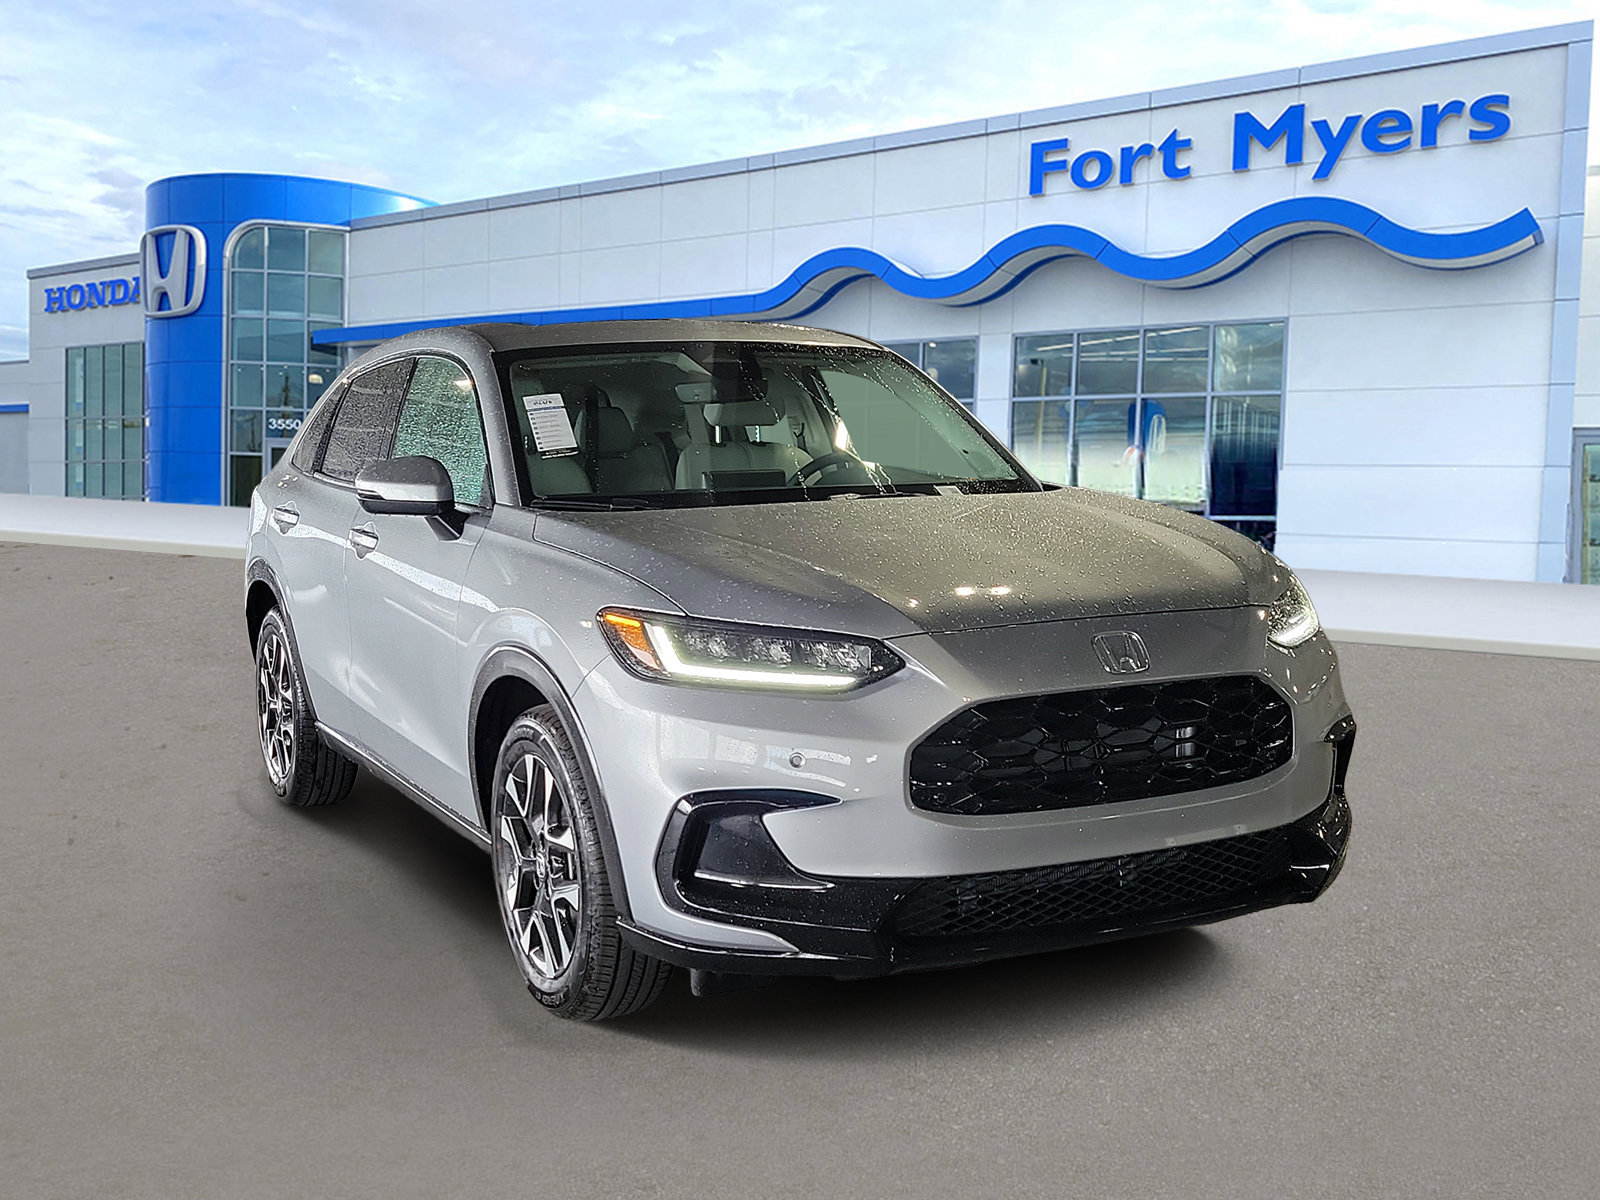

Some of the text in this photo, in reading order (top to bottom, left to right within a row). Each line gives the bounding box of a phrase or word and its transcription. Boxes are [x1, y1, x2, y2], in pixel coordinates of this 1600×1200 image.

[1029, 93, 1512, 197] Fort Myers
[268, 417, 302, 431] 3550
